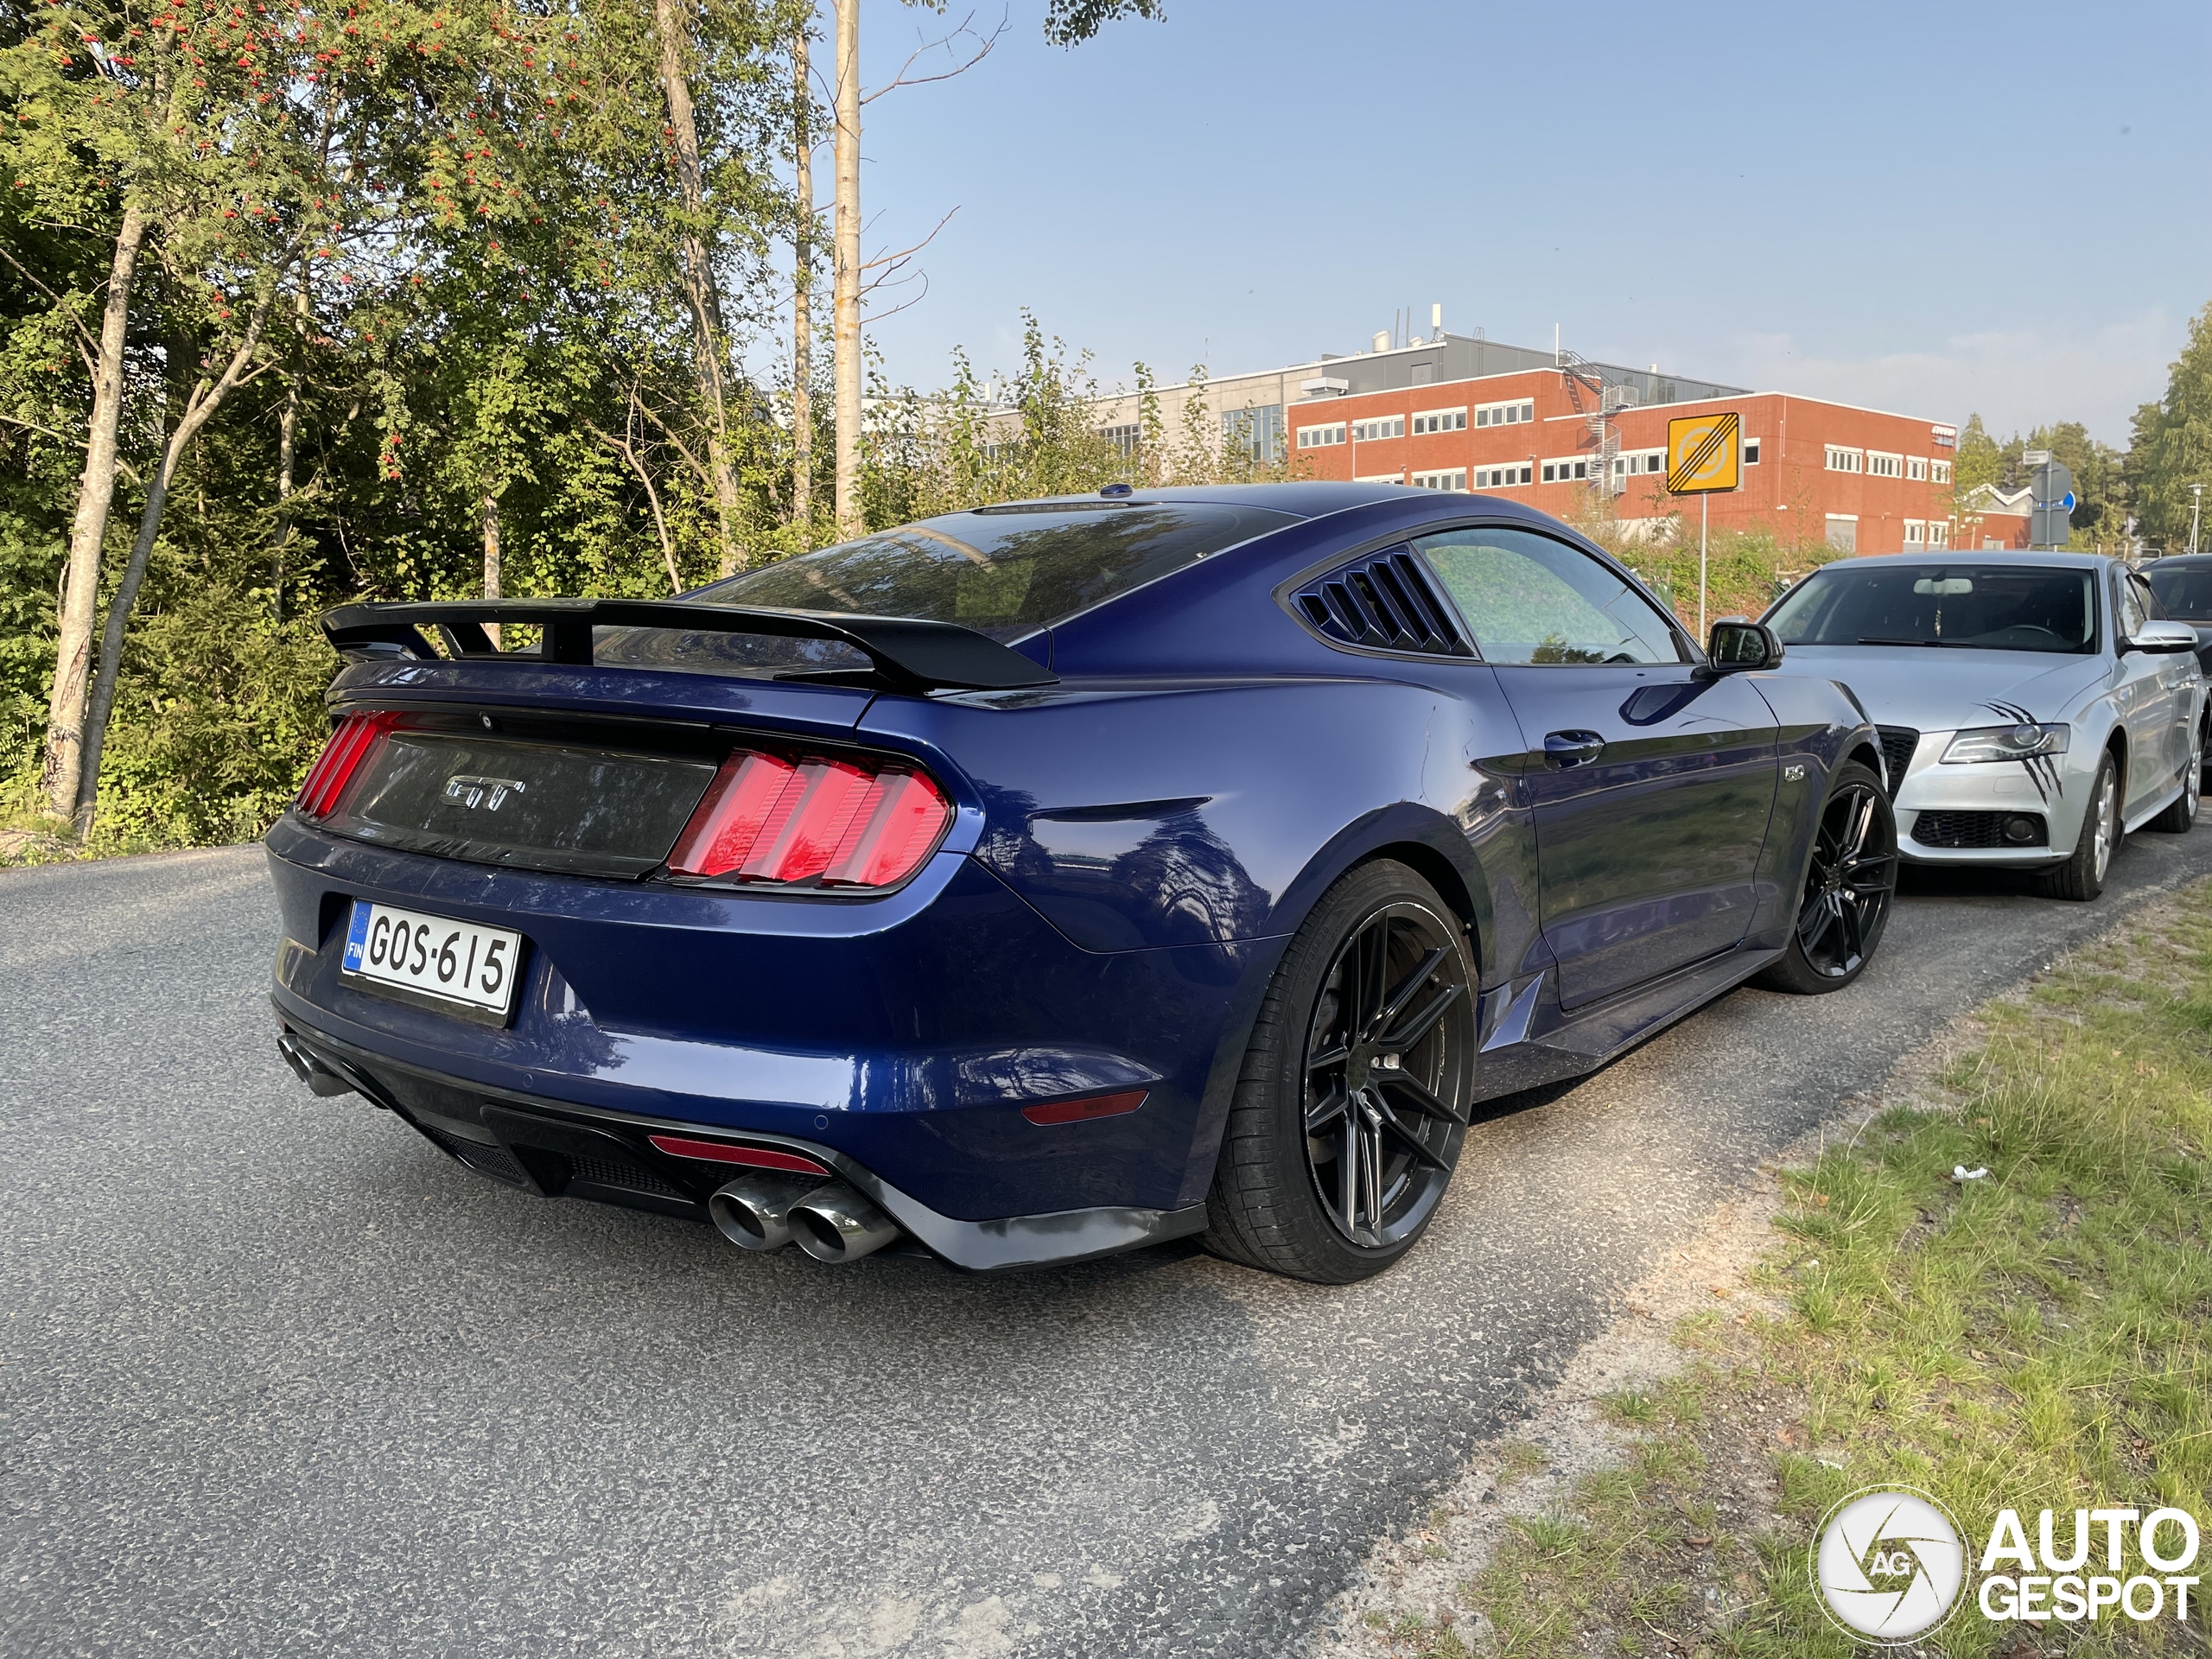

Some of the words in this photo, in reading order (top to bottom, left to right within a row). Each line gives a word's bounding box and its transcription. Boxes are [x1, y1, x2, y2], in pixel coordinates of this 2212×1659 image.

[439, 774, 526, 811] GT
[347, 942, 364, 959] FIN
[369, 915, 507, 994] GOS-615
